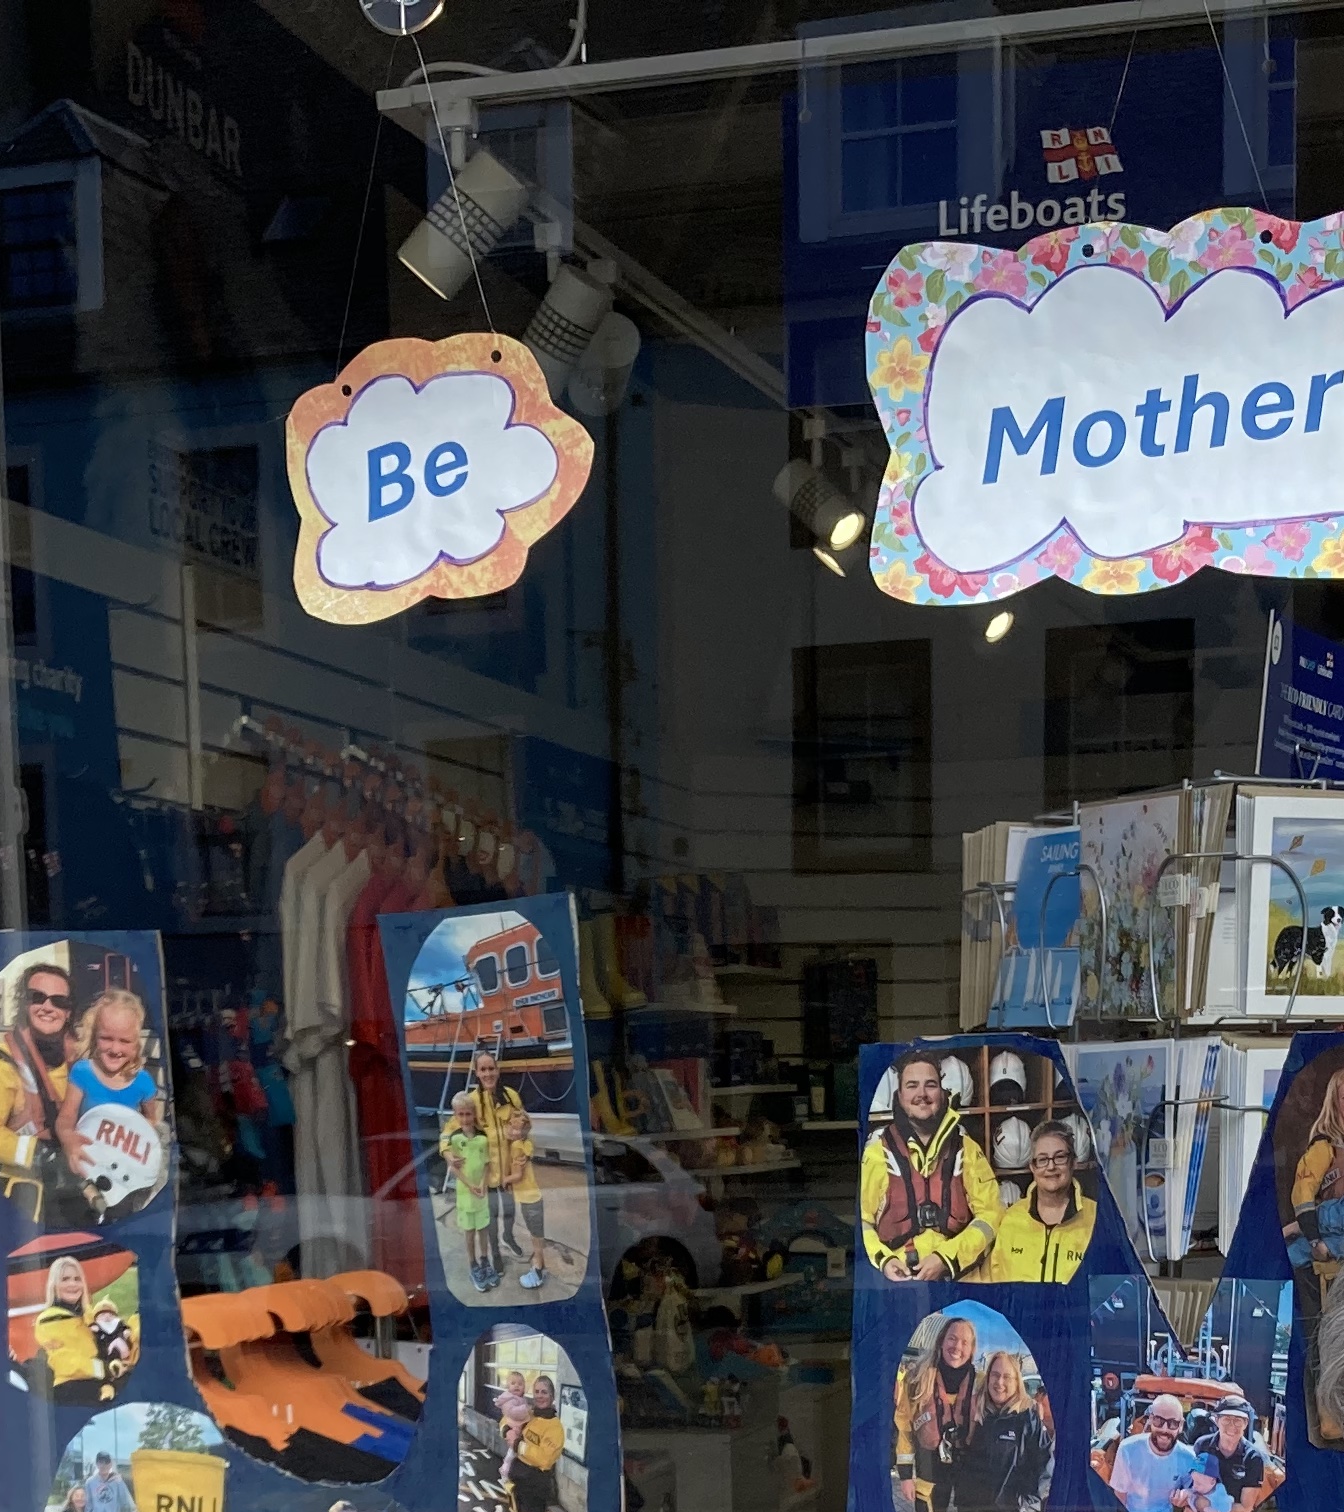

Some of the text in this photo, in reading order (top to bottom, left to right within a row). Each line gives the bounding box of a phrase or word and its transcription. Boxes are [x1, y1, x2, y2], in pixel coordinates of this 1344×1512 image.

[126, 40, 244, 178] DUNBAR
[937, 187, 1128, 237] Lifeboats
[365, 440, 470, 524] Be
[1041, 842, 1080, 862] SAILING
[96, 1118, 151, 1165] RNLI
